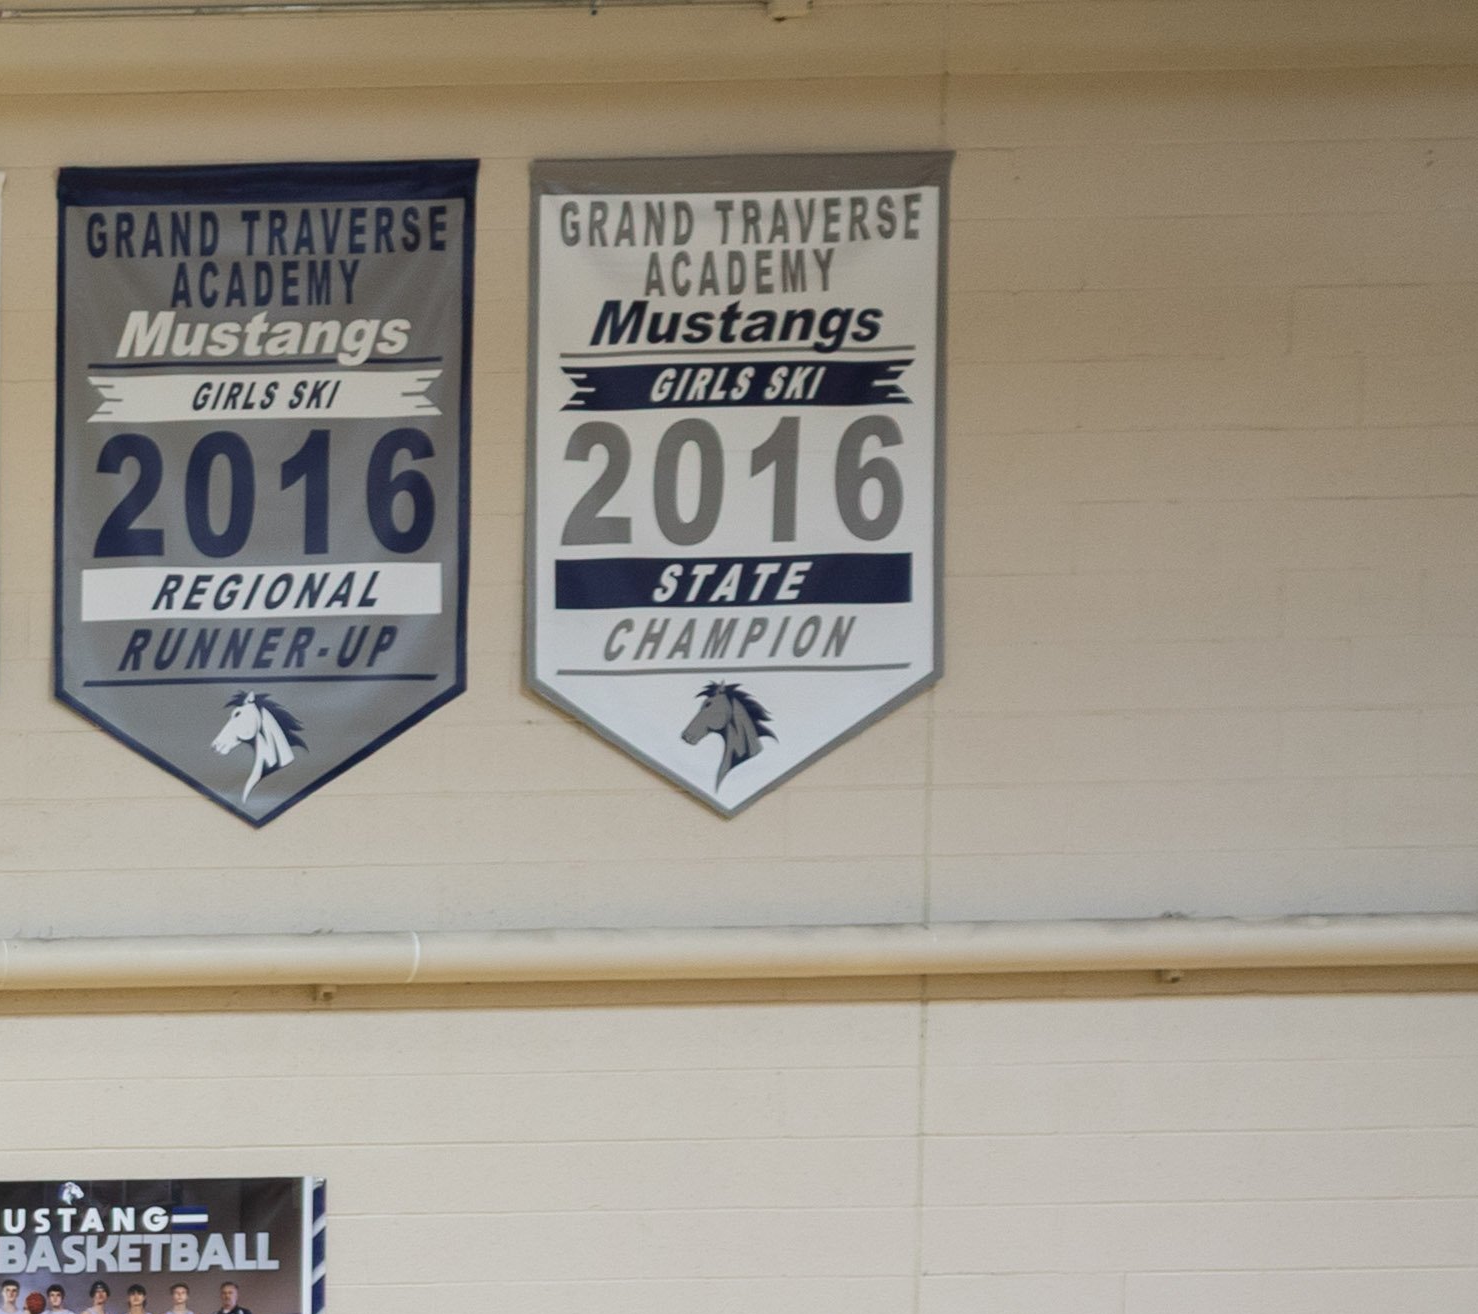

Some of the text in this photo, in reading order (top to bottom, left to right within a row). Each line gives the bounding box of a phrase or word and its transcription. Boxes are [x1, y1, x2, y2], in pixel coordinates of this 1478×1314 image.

[87, 205, 448, 259] GRAND TRAVERSE
[559, 193, 922, 247] GRAND TRAVERSE
[170, 259, 360, 308] ACADEMY
[644, 247, 834, 297] ACADEMY
[116, 310, 410, 366] Mustangs
[590, 298, 883, 354] Mustangs
[191, 379, 341, 411] GIRLS SKI
[649, 365, 826, 404] GIRLS SKI
[93, 428, 437, 559] 2016
[560, 414, 905, 547] 2016
[152, 570, 381, 612] REGIONAL
[652, 561, 813, 602] STATE
[118, 624, 398, 672] RUNNER-UP
[602, 615, 856, 661] CHAMPION
